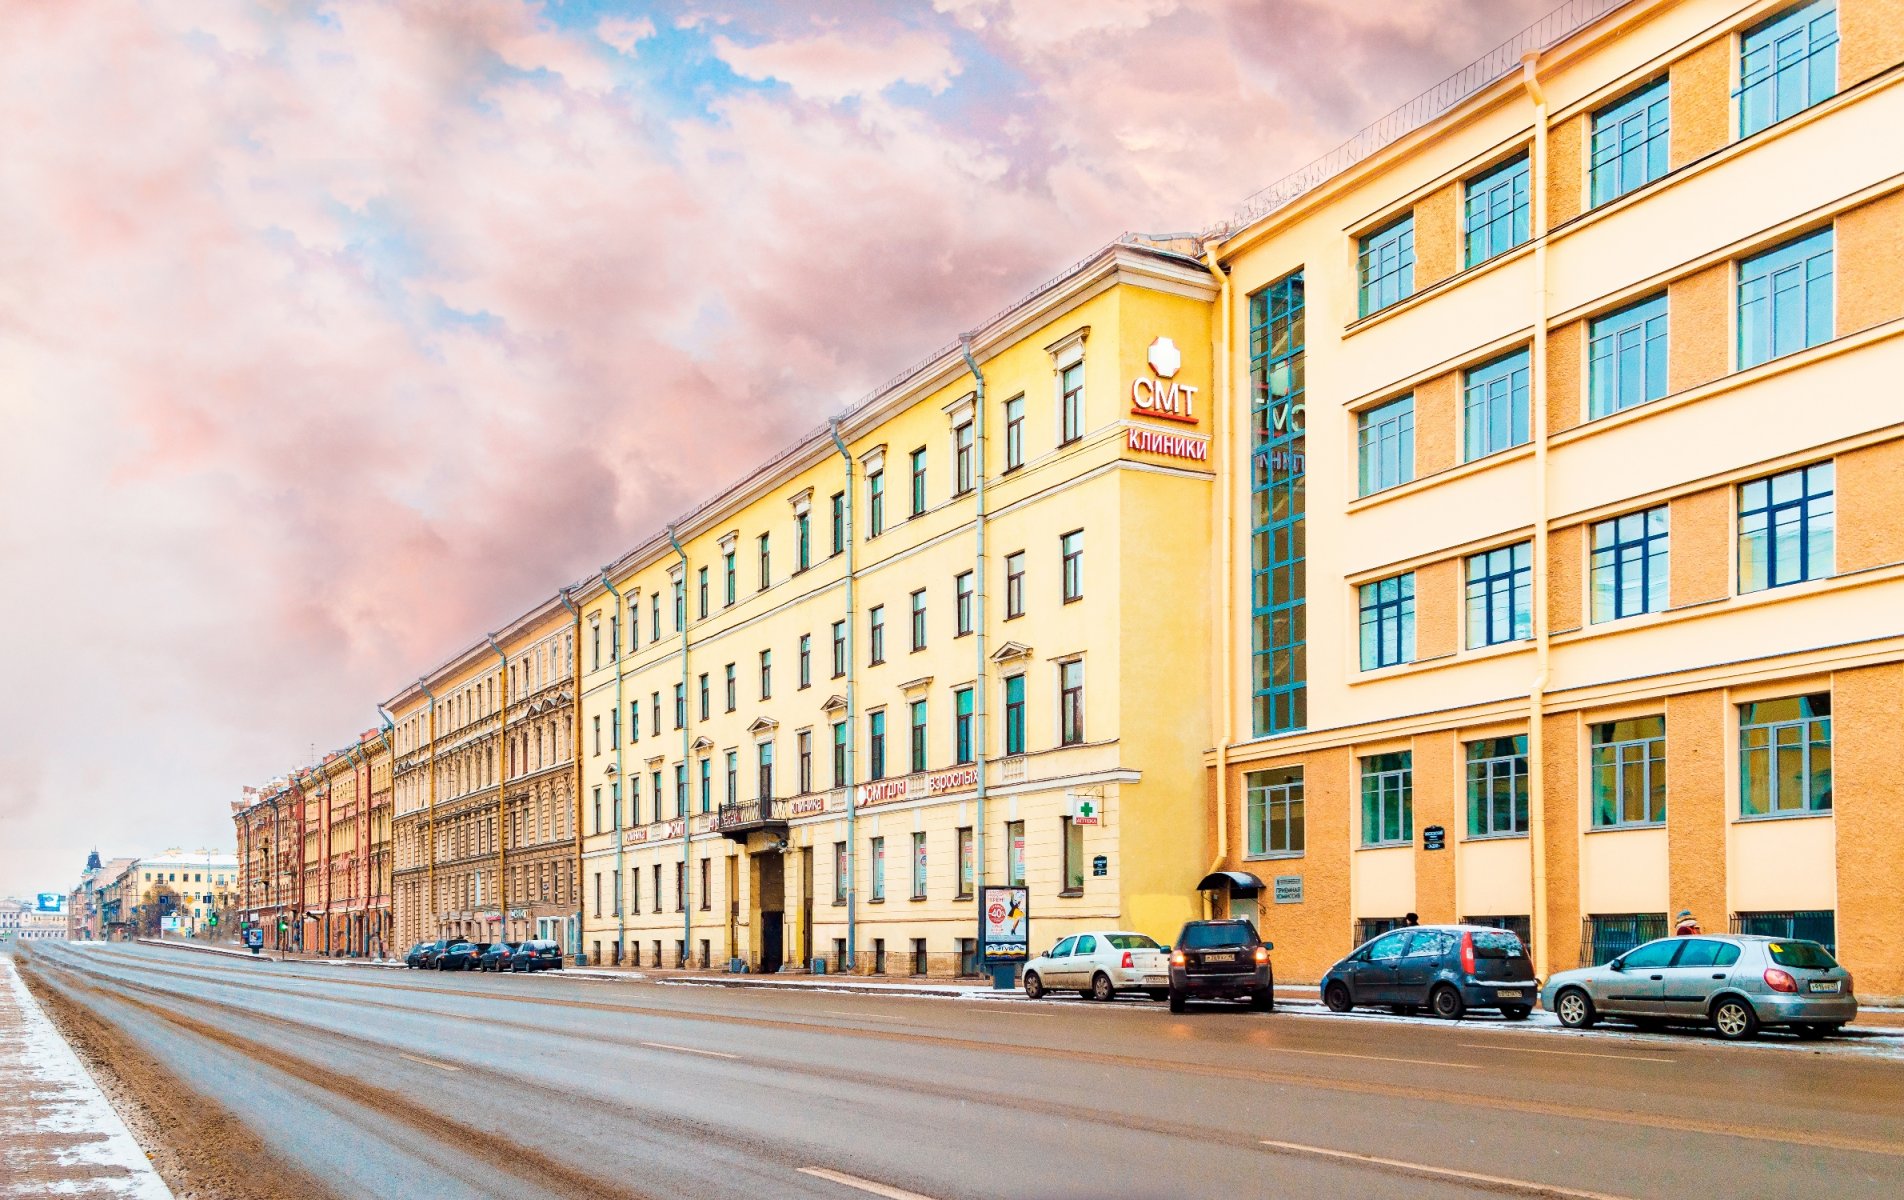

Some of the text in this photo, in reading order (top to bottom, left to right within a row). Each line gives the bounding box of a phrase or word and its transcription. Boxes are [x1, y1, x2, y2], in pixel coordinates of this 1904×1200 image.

[1132, 376, 1199, 416] СМТ
[1128, 428, 1207, 461] КЛИНИКИ
[866, 783, 889, 802] СМТ
